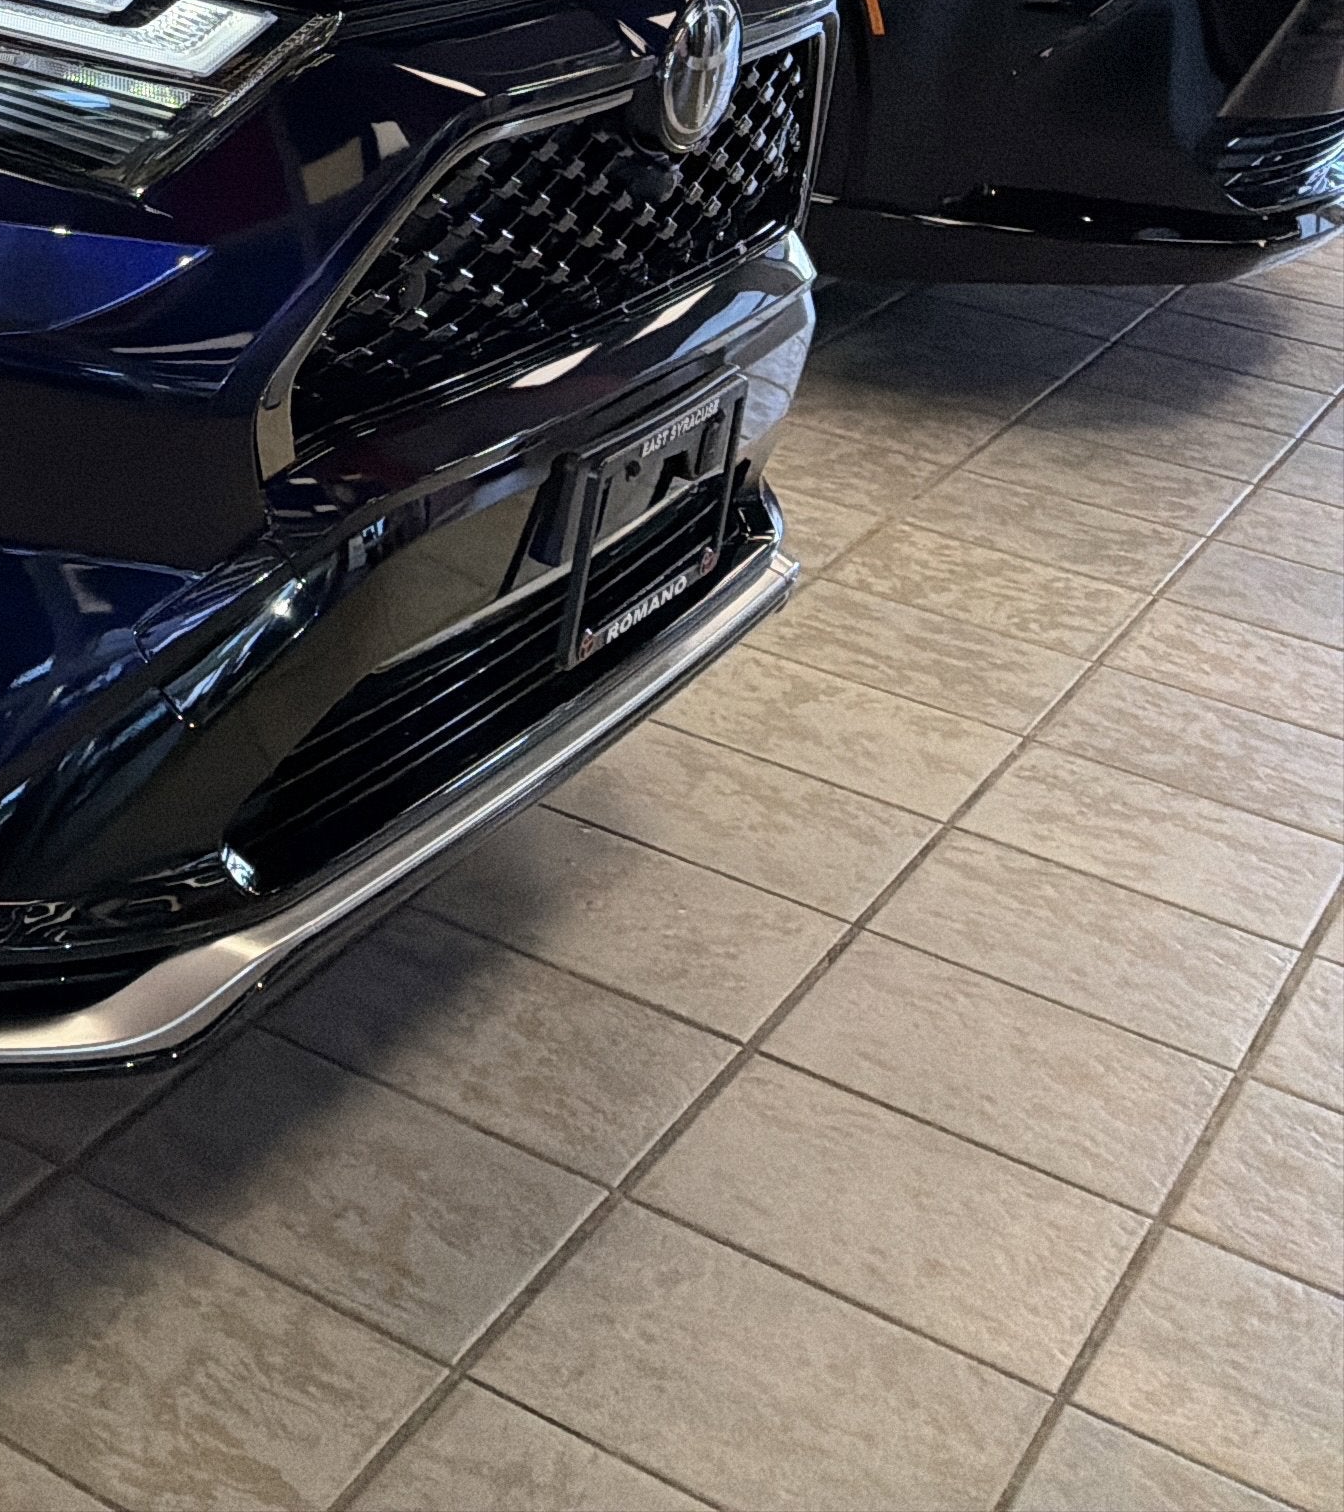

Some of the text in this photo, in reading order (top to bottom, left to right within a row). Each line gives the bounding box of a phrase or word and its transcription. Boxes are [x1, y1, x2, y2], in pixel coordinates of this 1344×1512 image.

[641, 397, 720, 458] EAST SYRACUSE
[605, 575, 687, 644] ROMANO
